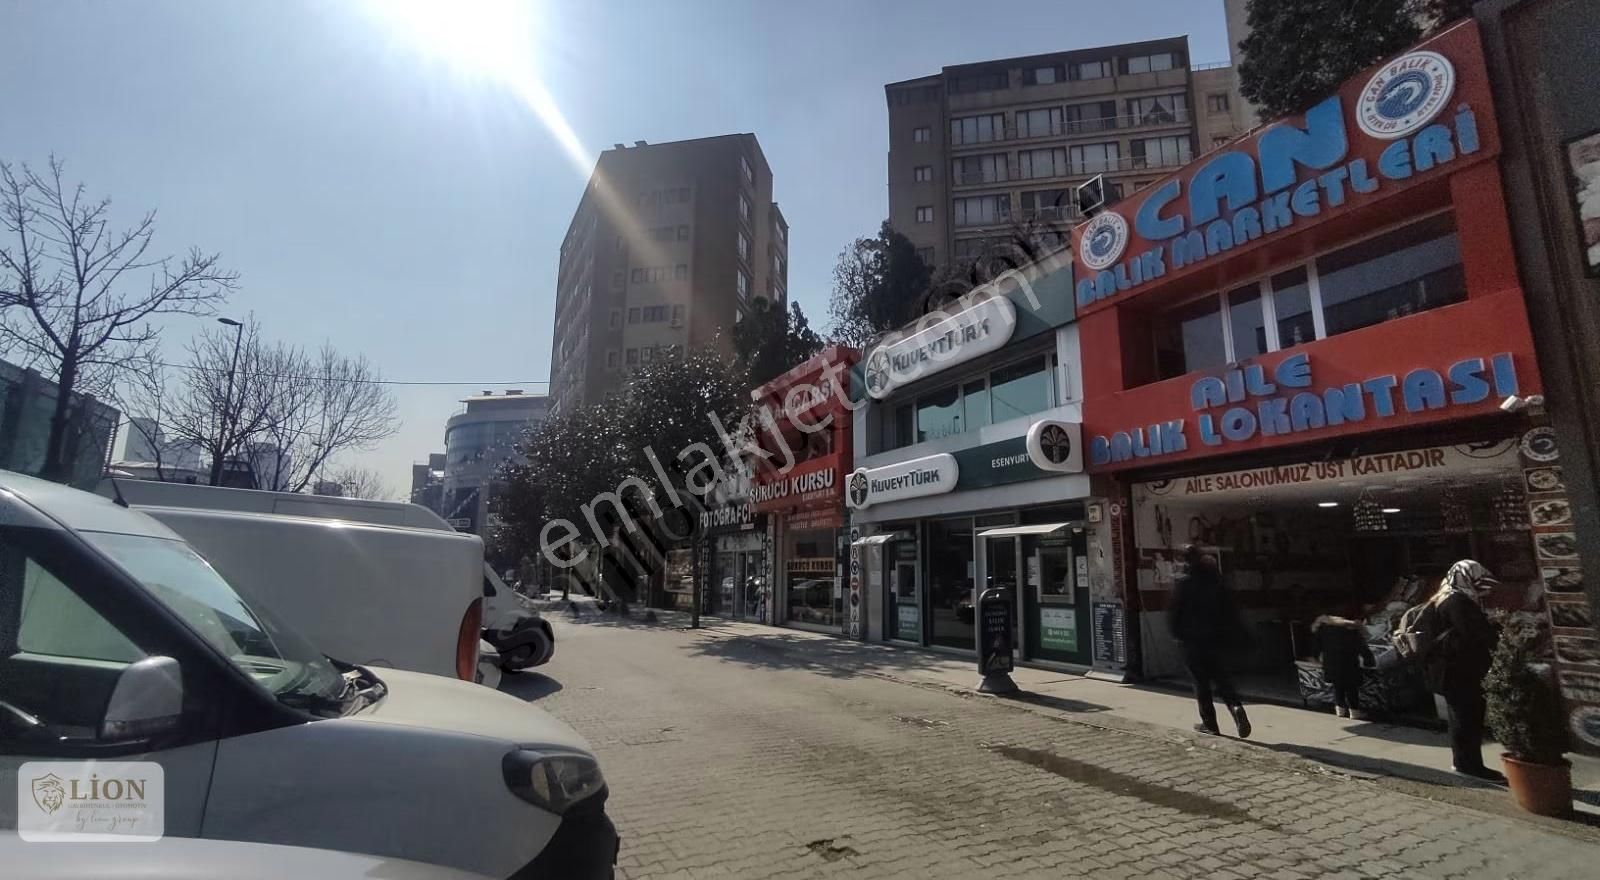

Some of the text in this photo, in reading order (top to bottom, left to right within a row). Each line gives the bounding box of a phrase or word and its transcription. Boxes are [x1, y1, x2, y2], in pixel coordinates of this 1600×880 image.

[1077, 103, 1480, 306] BALIK MARKETLERİ
[1135, 96, 1348, 241] CAN
[1091, 419, 1188, 466] BALIK
[1200, 352, 1519, 446] LOKANTASI
[1192, 353, 1312, 410] AİLE
[791, 467, 834, 495] KURSU
[1185, 475, 1213, 495] AİLE
[1216, 465, 1311, 490] SALONUMUZ
[1352, 449, 1446, 475] KATTADIR
